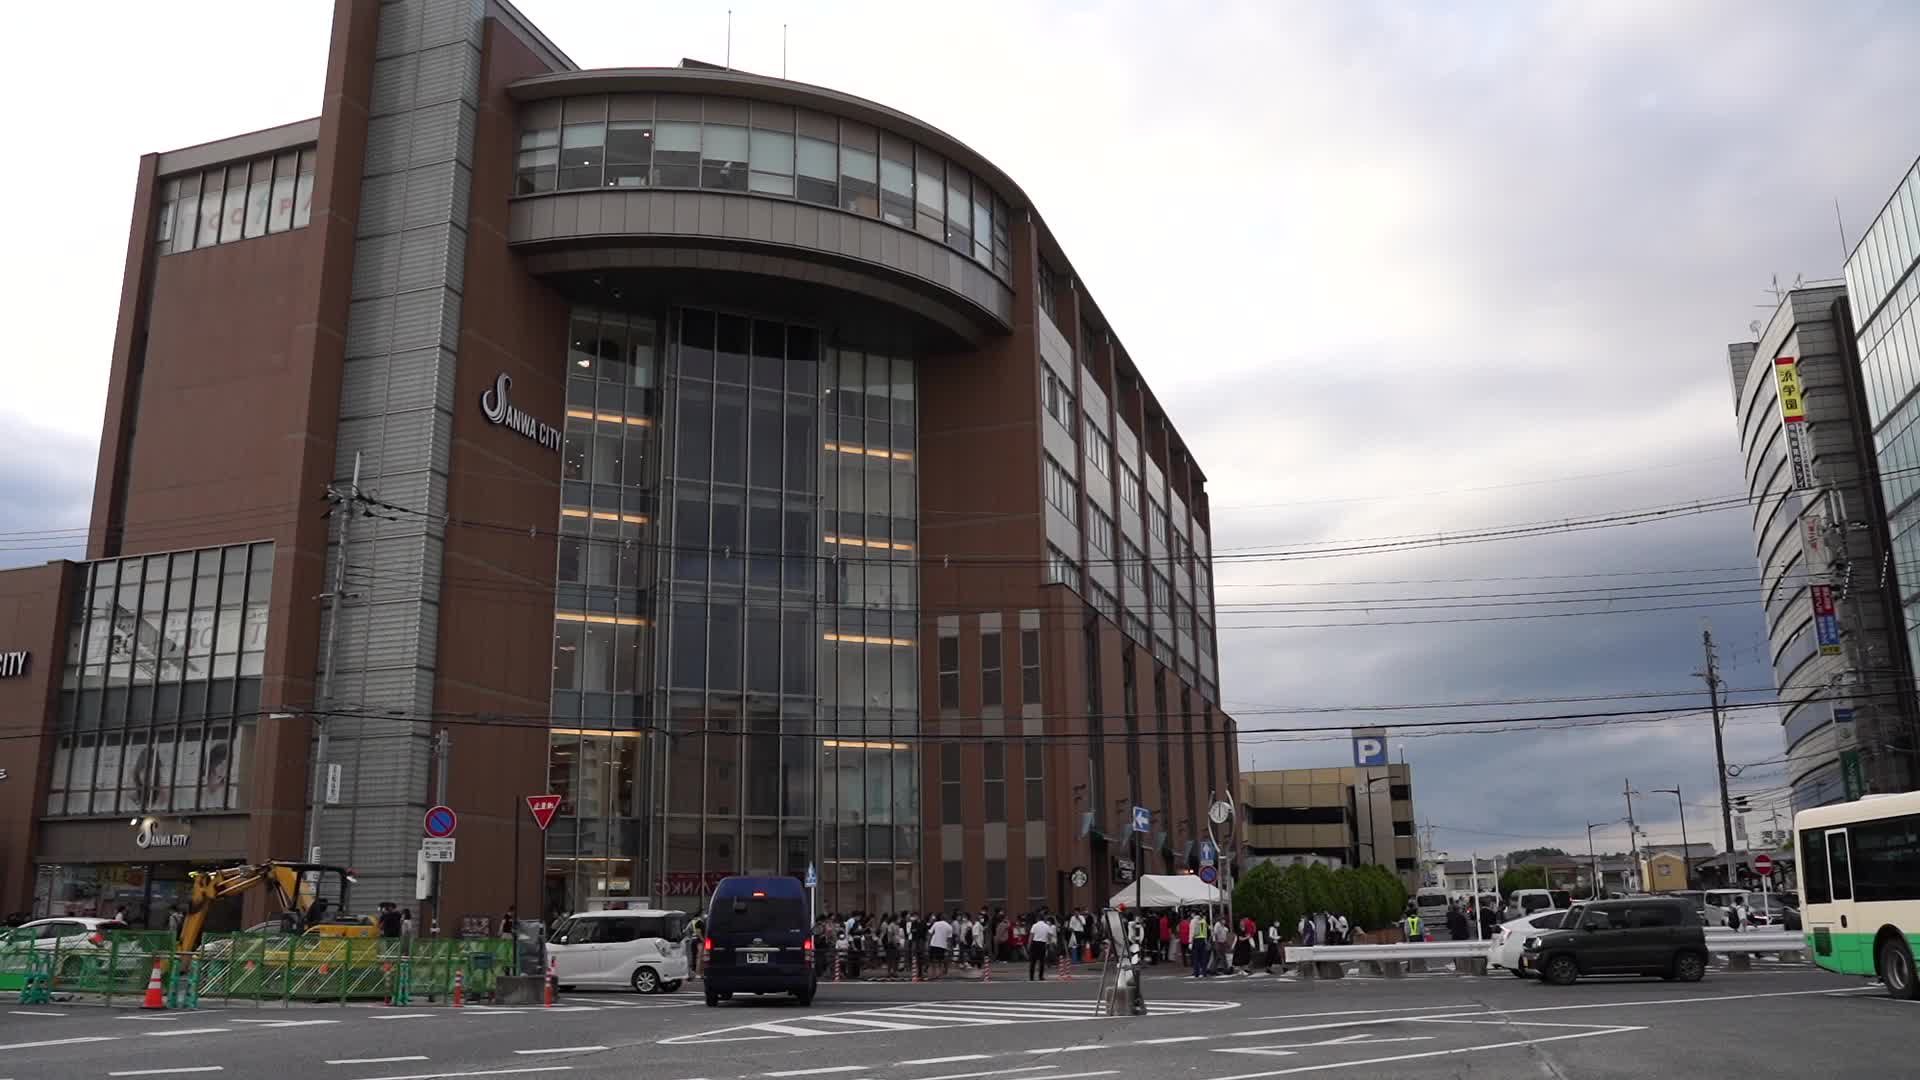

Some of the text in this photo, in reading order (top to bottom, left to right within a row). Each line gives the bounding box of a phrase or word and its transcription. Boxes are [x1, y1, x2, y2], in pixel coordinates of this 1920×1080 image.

[482, 373, 562, 452] SANWA CITY
[1357, 739, 1382, 764] P
[136, 817, 190, 849] SANWA CITY
